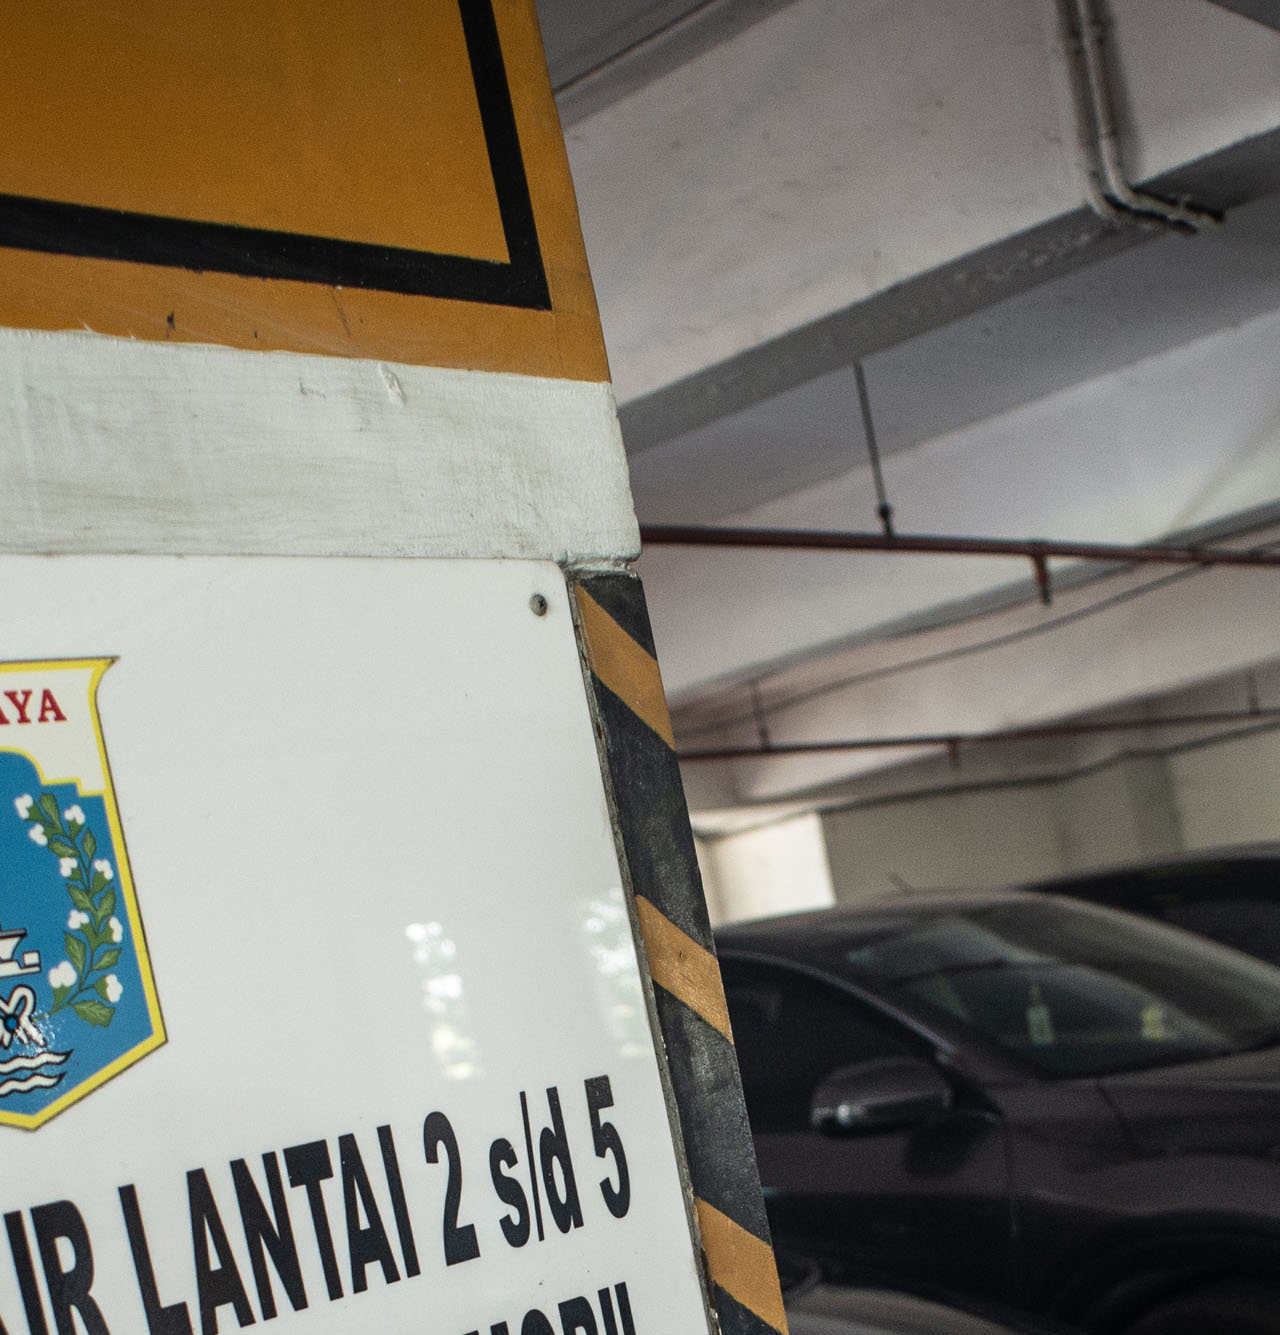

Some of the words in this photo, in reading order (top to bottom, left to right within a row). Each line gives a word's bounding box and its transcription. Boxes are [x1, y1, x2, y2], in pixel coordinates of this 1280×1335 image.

[423, 1110, 481, 1267] 2
[488, 1085, 584, 1249] s/d
[584, 1074, 632, 1219] 5
